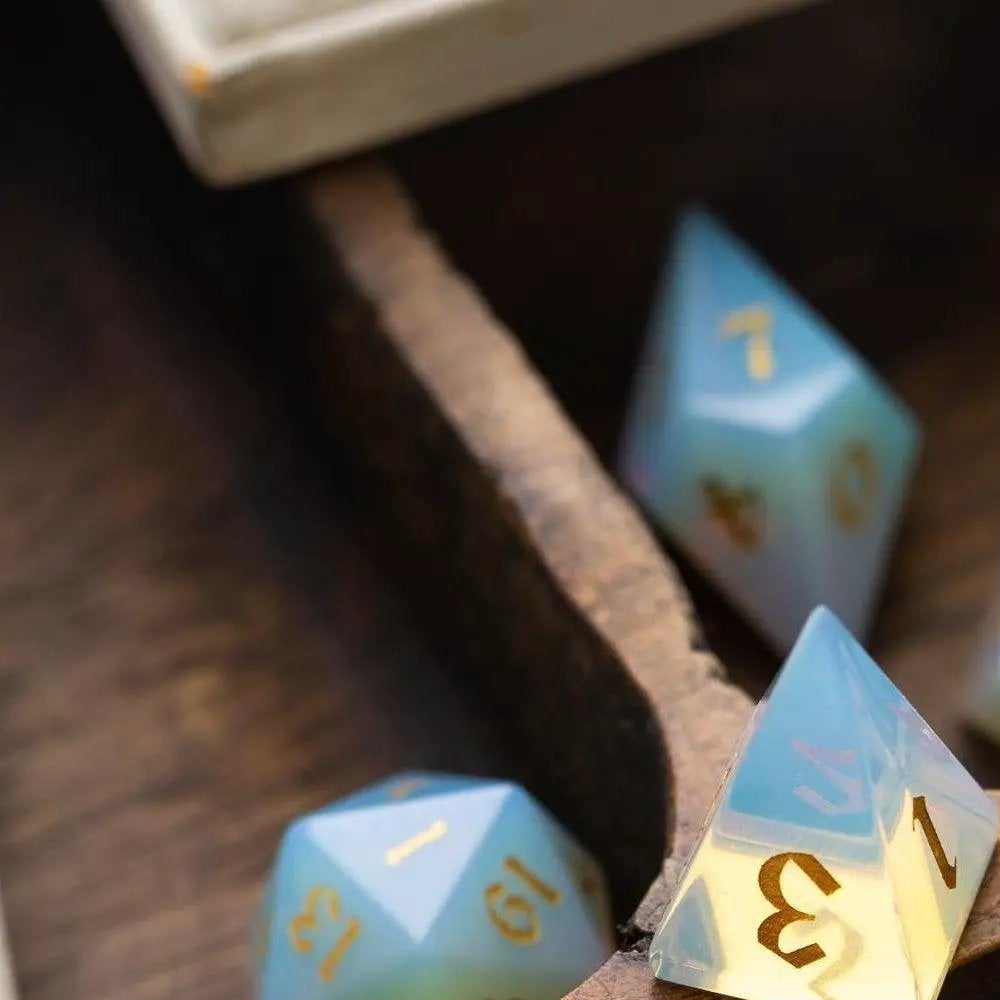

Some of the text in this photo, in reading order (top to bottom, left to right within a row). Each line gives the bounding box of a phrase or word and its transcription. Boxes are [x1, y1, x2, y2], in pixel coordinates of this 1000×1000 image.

[385, 819, 450, 868] 1
[912, 795, 958, 890] 1
[757, 851, 843, 969] 3
